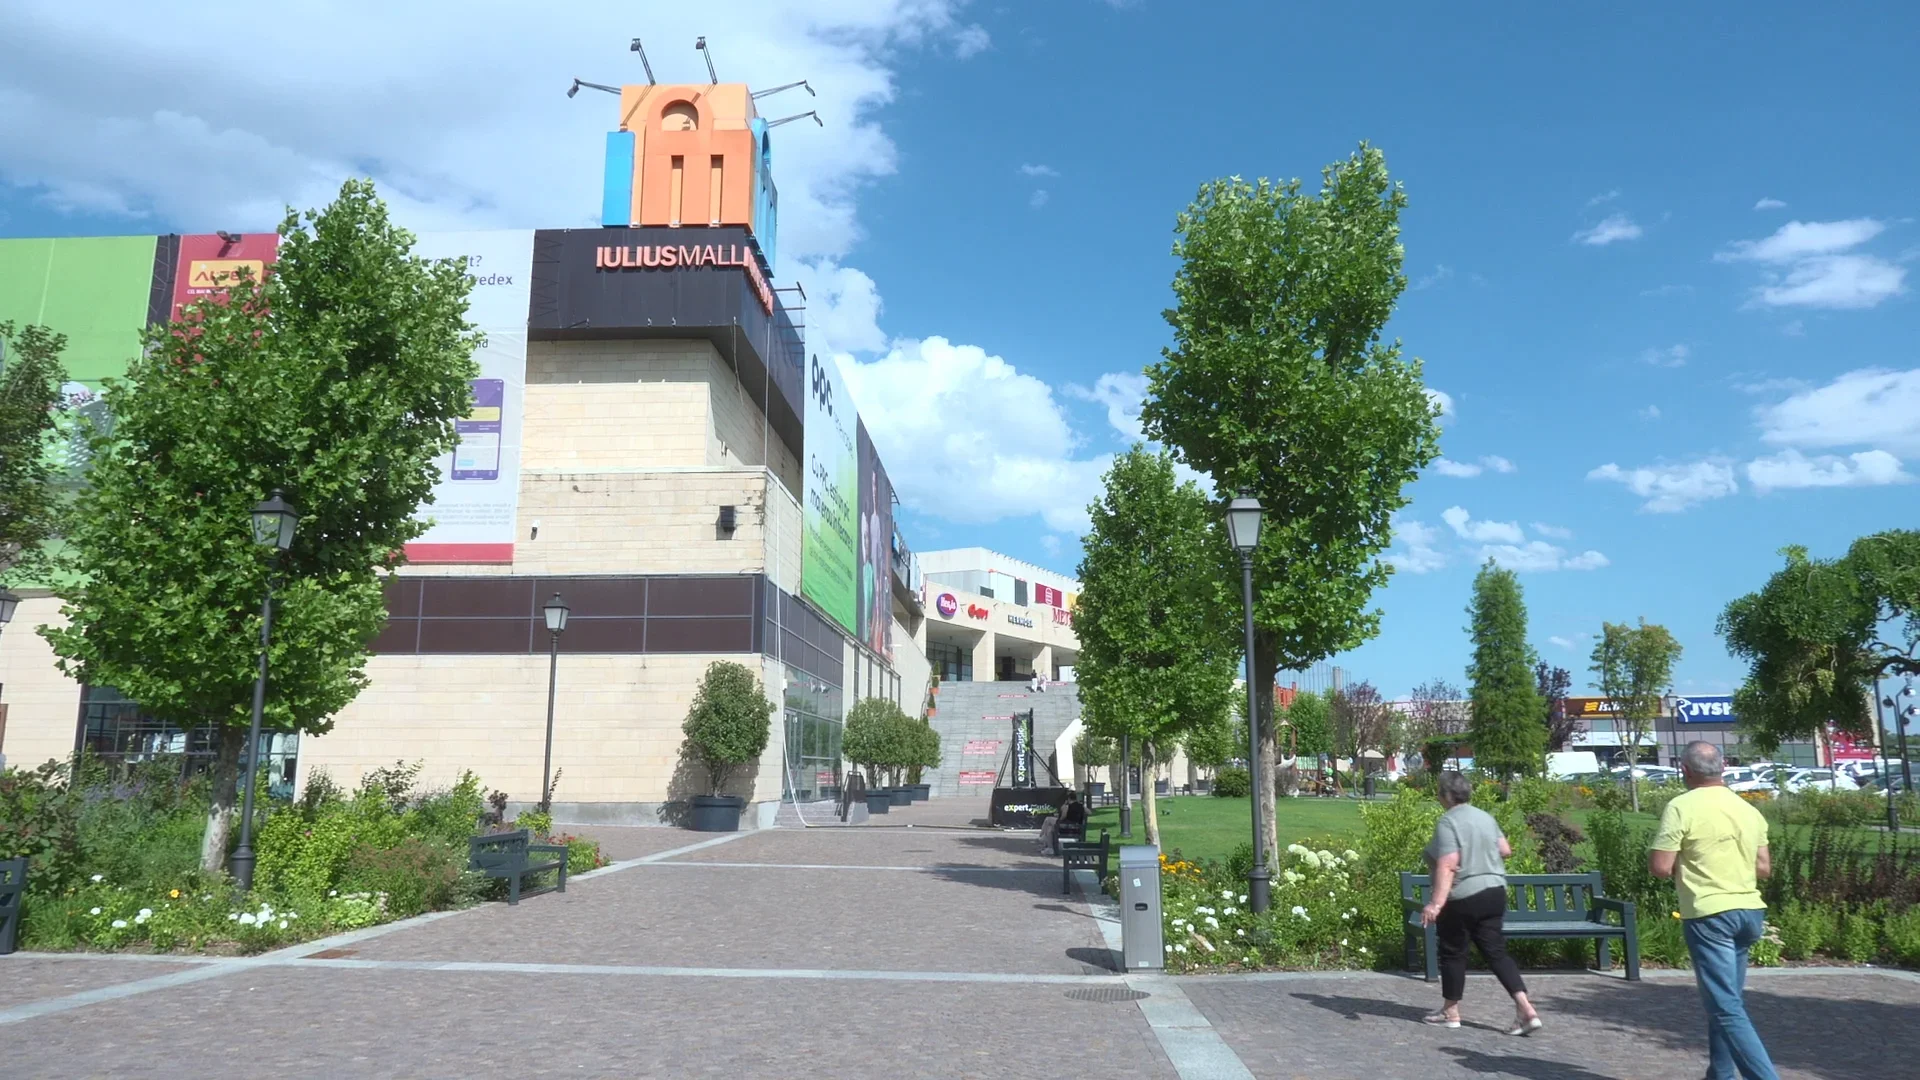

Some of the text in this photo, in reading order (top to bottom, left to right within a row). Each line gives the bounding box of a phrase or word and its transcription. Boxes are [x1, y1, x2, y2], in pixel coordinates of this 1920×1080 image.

[596, 245, 744, 267] IULIUSMALL
[463, 273, 513, 286] edex
[812, 353, 833, 417] ppc
